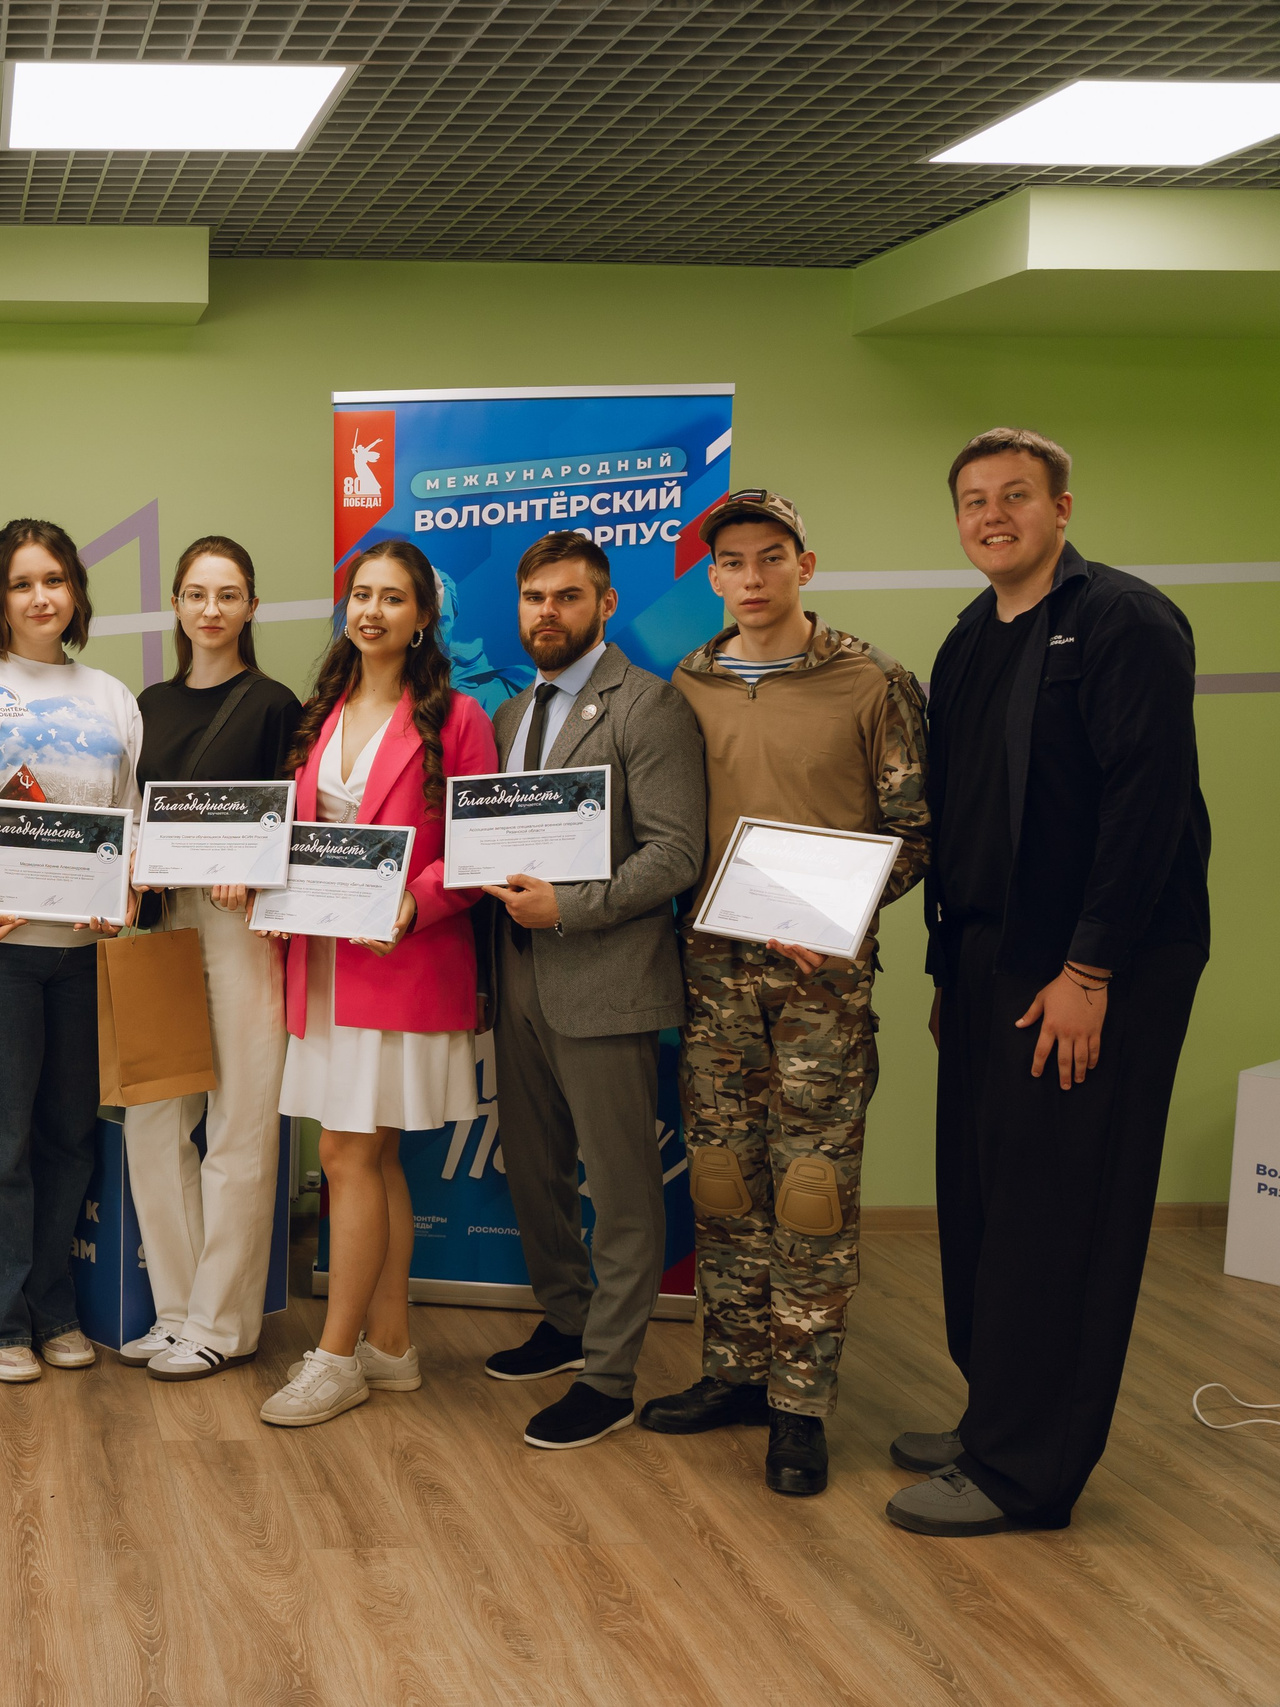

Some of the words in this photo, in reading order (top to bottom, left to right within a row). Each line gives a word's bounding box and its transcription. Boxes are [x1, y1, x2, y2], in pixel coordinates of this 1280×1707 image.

[426, 452, 672, 491] МЕЖДУНАРОДНЫЙ
[343, 476, 361, 495] 80
[343, 497, 382, 508] ПОБЕДА!
[414, 480, 682, 532] ВОЛОНТЁРСКИЙ
[154, 796, 249, 815] Благодарность
[458, 789, 562, 808] Благодарность
[291, 838, 367, 857] агодарность
[1256, 1163, 1280, 1180] Во
[467, 1225, 520, 1236] росмоло
